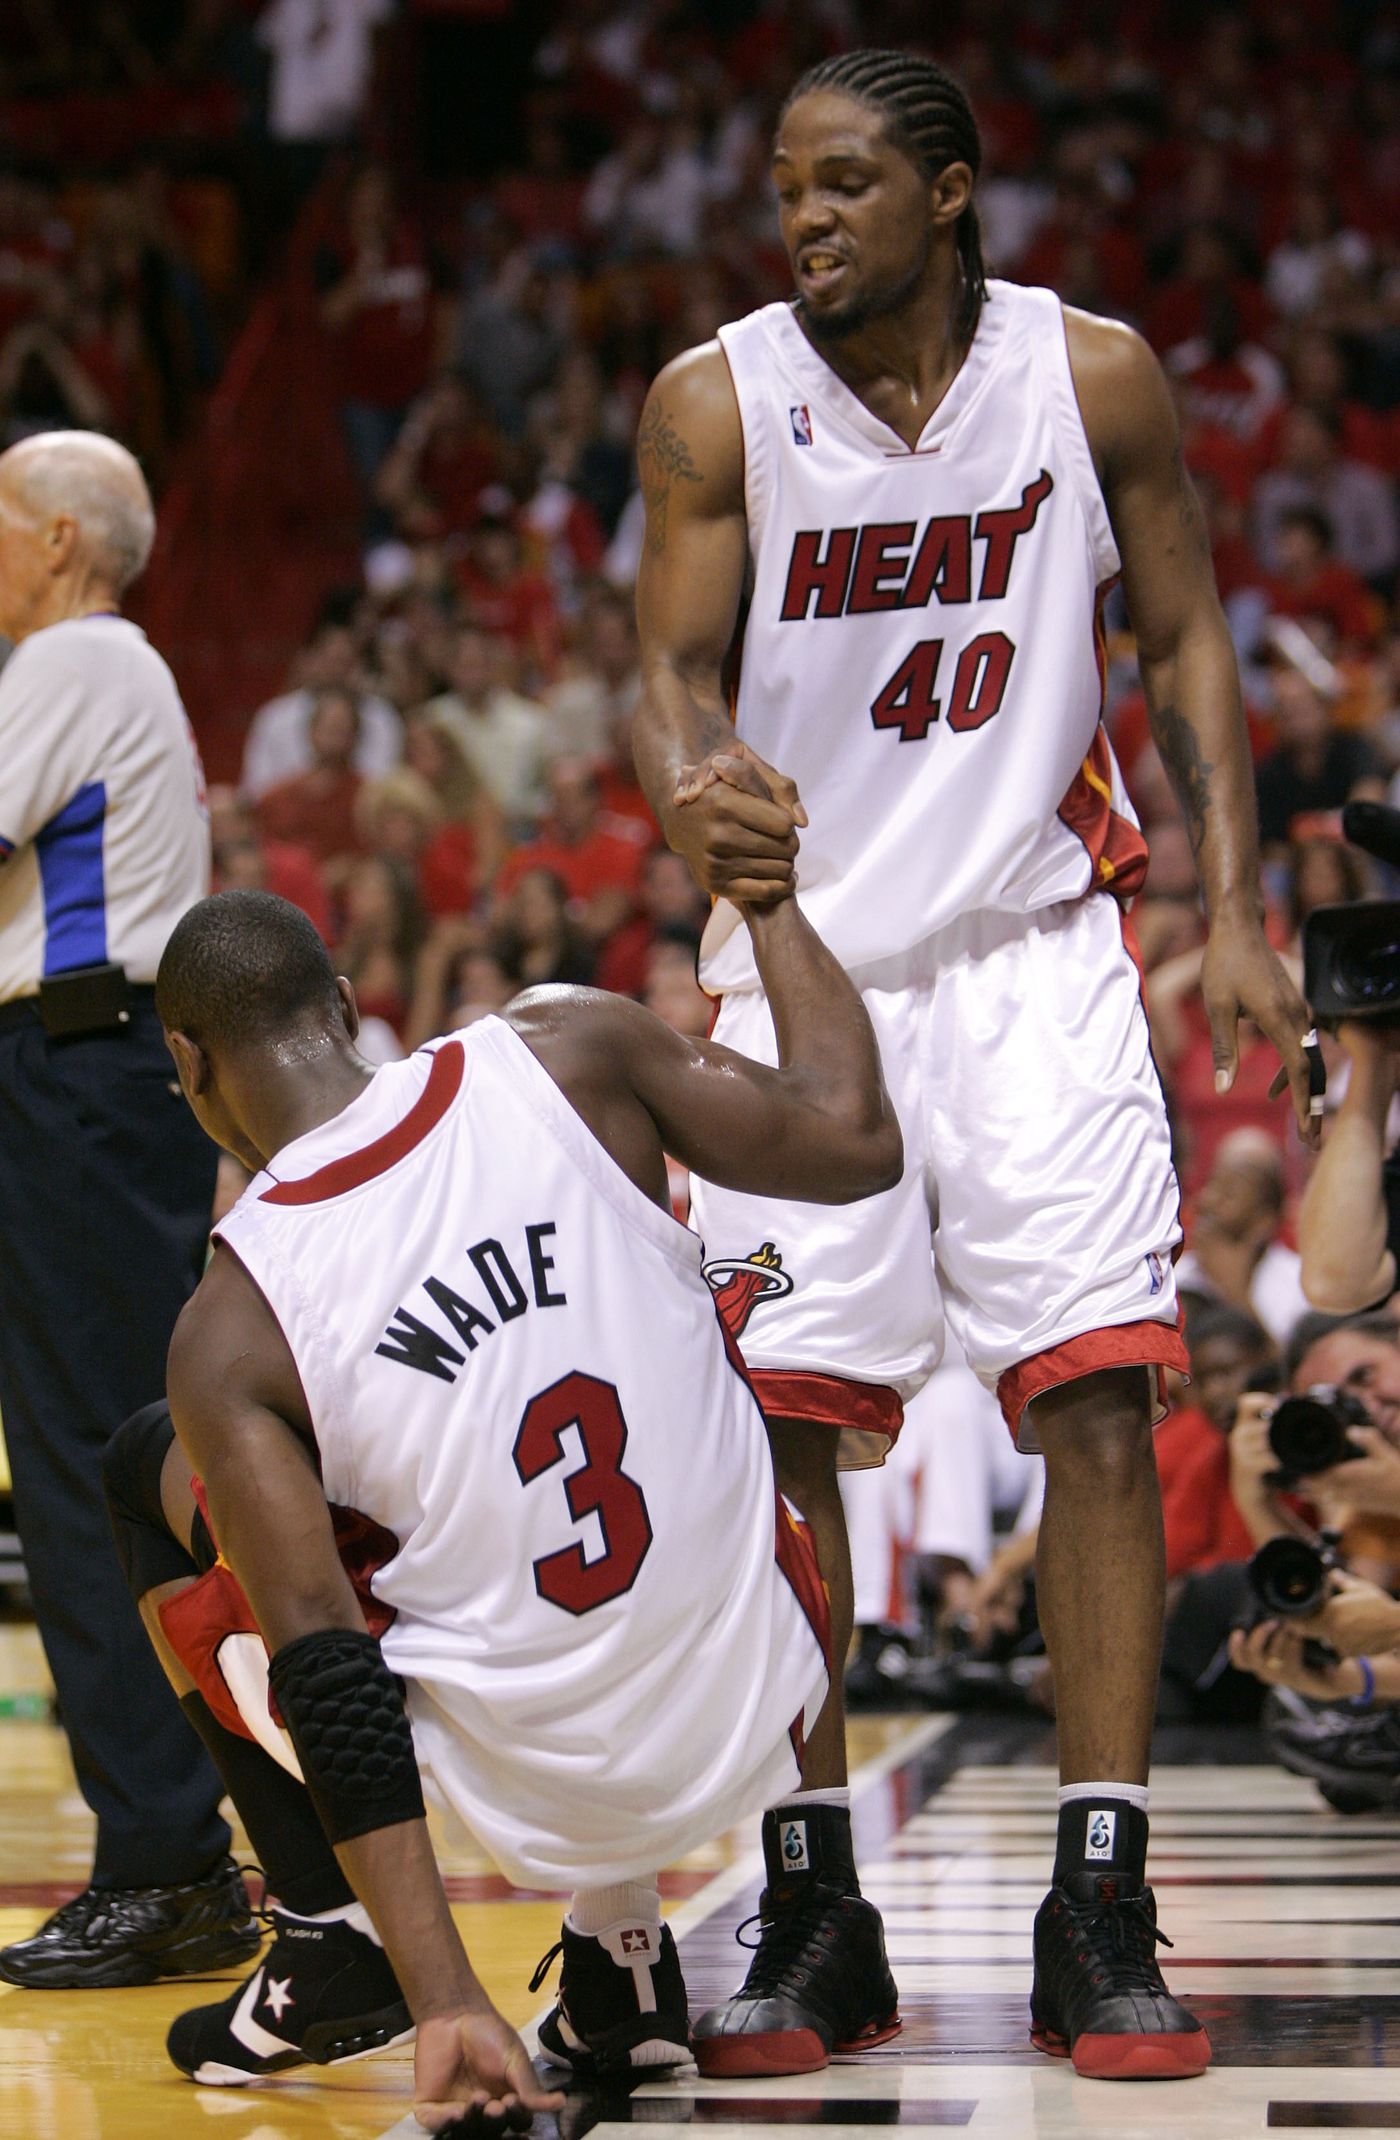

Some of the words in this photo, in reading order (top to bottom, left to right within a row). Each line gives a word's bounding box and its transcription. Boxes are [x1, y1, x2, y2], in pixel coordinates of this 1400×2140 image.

[779, 468, 1054, 622] HEAT
[870, 630, 1017, 742] 40
[374, 1221, 568, 1385] WADE
[511, 1369, 654, 1617] 3
